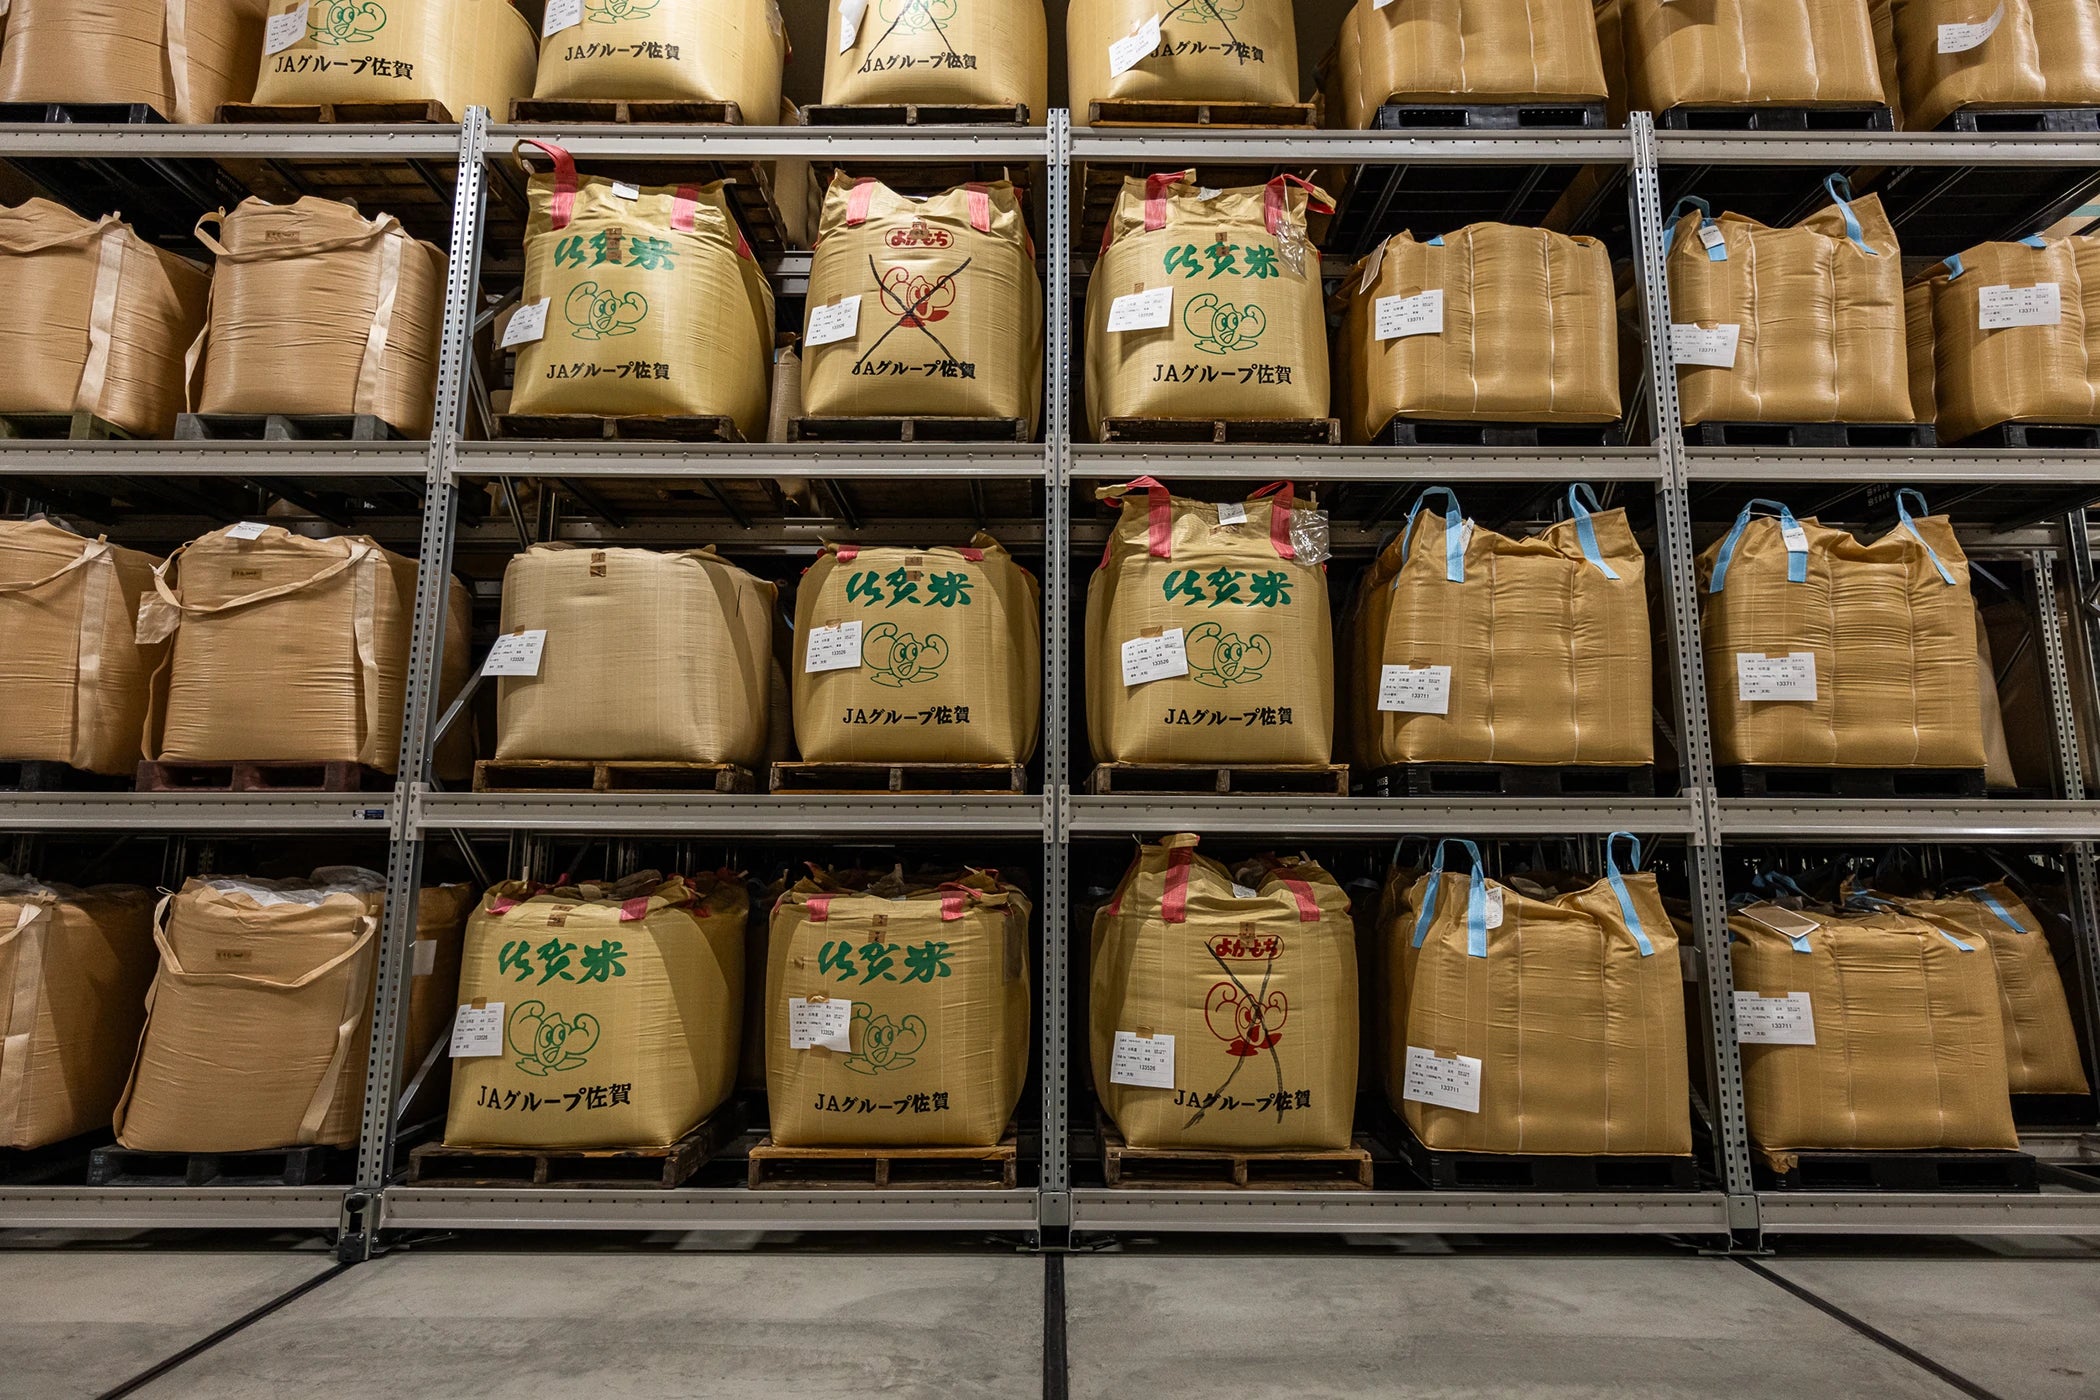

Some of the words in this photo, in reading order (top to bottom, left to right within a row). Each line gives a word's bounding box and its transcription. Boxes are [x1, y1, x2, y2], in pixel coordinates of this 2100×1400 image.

[564, 41, 681, 62] JAグループ佐賀
[862, 52, 978, 73] JAグループ佐賀
[274, 55, 414, 81] JAグループ佐賀
[1162, 241, 1280, 280] 佐賀米
[545, 360, 670, 380] JAグループ佐賀
[851, 360, 976, 380] JAグループ佐賀
[1152, 363, 1293, 386] JAグループ佐賀
[845, 566, 974, 608] 佐賀米
[1162, 567, 1294, 608] 佐賀米
[842, 705, 970, 727] JAグループ佐賀
[1163, 706, 1294, 728] JAグループ佐賀
[498, 937, 628, 985] 佐賀米
[817, 940, 956, 985] 佐賀米
[476, 1082, 632, 1112] JAグループ佐賀
[814, 1091, 950, 1115] JAグループ佐賀
[1173, 1089, 1311, 1113] JAグループ佐賀
